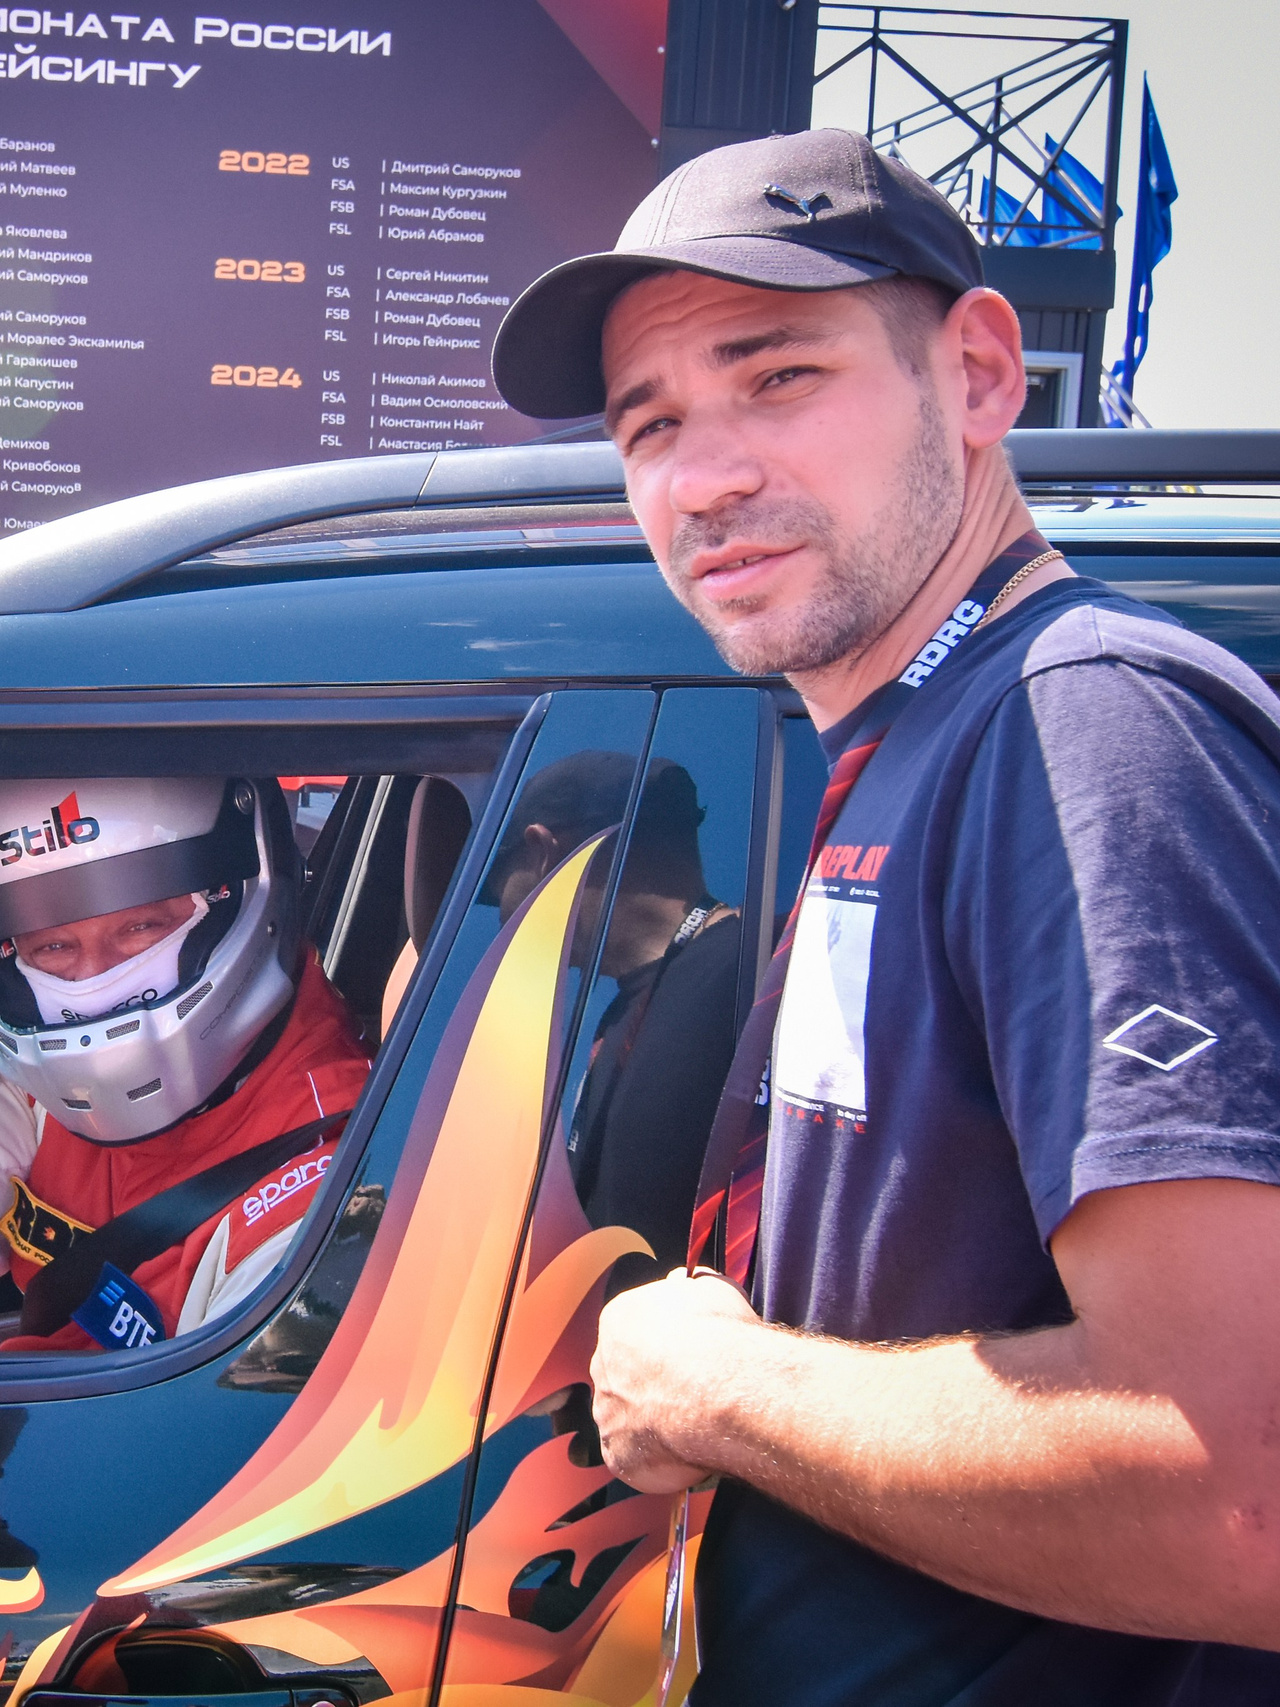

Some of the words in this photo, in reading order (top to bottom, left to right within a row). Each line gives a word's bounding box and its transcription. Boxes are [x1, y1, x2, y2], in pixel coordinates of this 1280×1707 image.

[194, 18, 391, 56] РОССИИ
[0, 138, 55, 152] Баранов
[21, 162, 76, 175] Матвеев
[219, 151, 309, 174] 2022
[332, 157, 350, 169] US
[391, 160, 450, 176] Дмитрий
[452, 164, 521, 179] Саморуков
[10, 183, 67, 197] Муленко
[390, 182, 439, 196] Максим
[330, 201, 355, 213] FSB
[389, 205, 429, 218] Роман
[431, 207, 486, 222] Дубовец
[6, 225, 67, 239] Яковлева
[388, 227, 425, 241] Юрий
[428, 229, 484, 243] Абрамов
[18, 248, 92, 263] Мандриков
[17, 270, 88, 285] Саморуков
[216, 259, 305, 282] 2023
[386, 268, 431, 282] Сергей
[434, 271, 488, 283] Никитин
[327, 286, 350, 298] FSA
[385, 290, 454, 305] Александр
[456, 293, 510, 306] Лобачев
[16, 311, 86, 326] Саморуков
[384, 311, 424, 324] Роман
[426, 314, 481, 328] Дубовец
[325, 330, 347, 341] FSL
[383, 334, 421, 348] Игорь
[423, 335, 480, 350] Гейнрихс
[7, 354, 78, 368] Гаракишев
[15, 377, 74, 391] Капустин
[211, 365, 301, 388] 2024
[382, 373, 435, 385] Николай
[438, 375, 486, 388] Акимов
[13, 397, 84, 412] Саморуков
[381, 394, 421, 408] Вадим
[424, 393, 509, 410] Осмоловский
[321, 413, 345, 425] FSB
[380, 416, 451, 429] Константин
[454, 419, 484, 430] Найт
[378, 437, 442, 451] Анастасия
[3, 459, 81, 473] Кривобоков
[11, 481, 81, 496] Саморуков
[898, 599, 986, 688] RDRC
